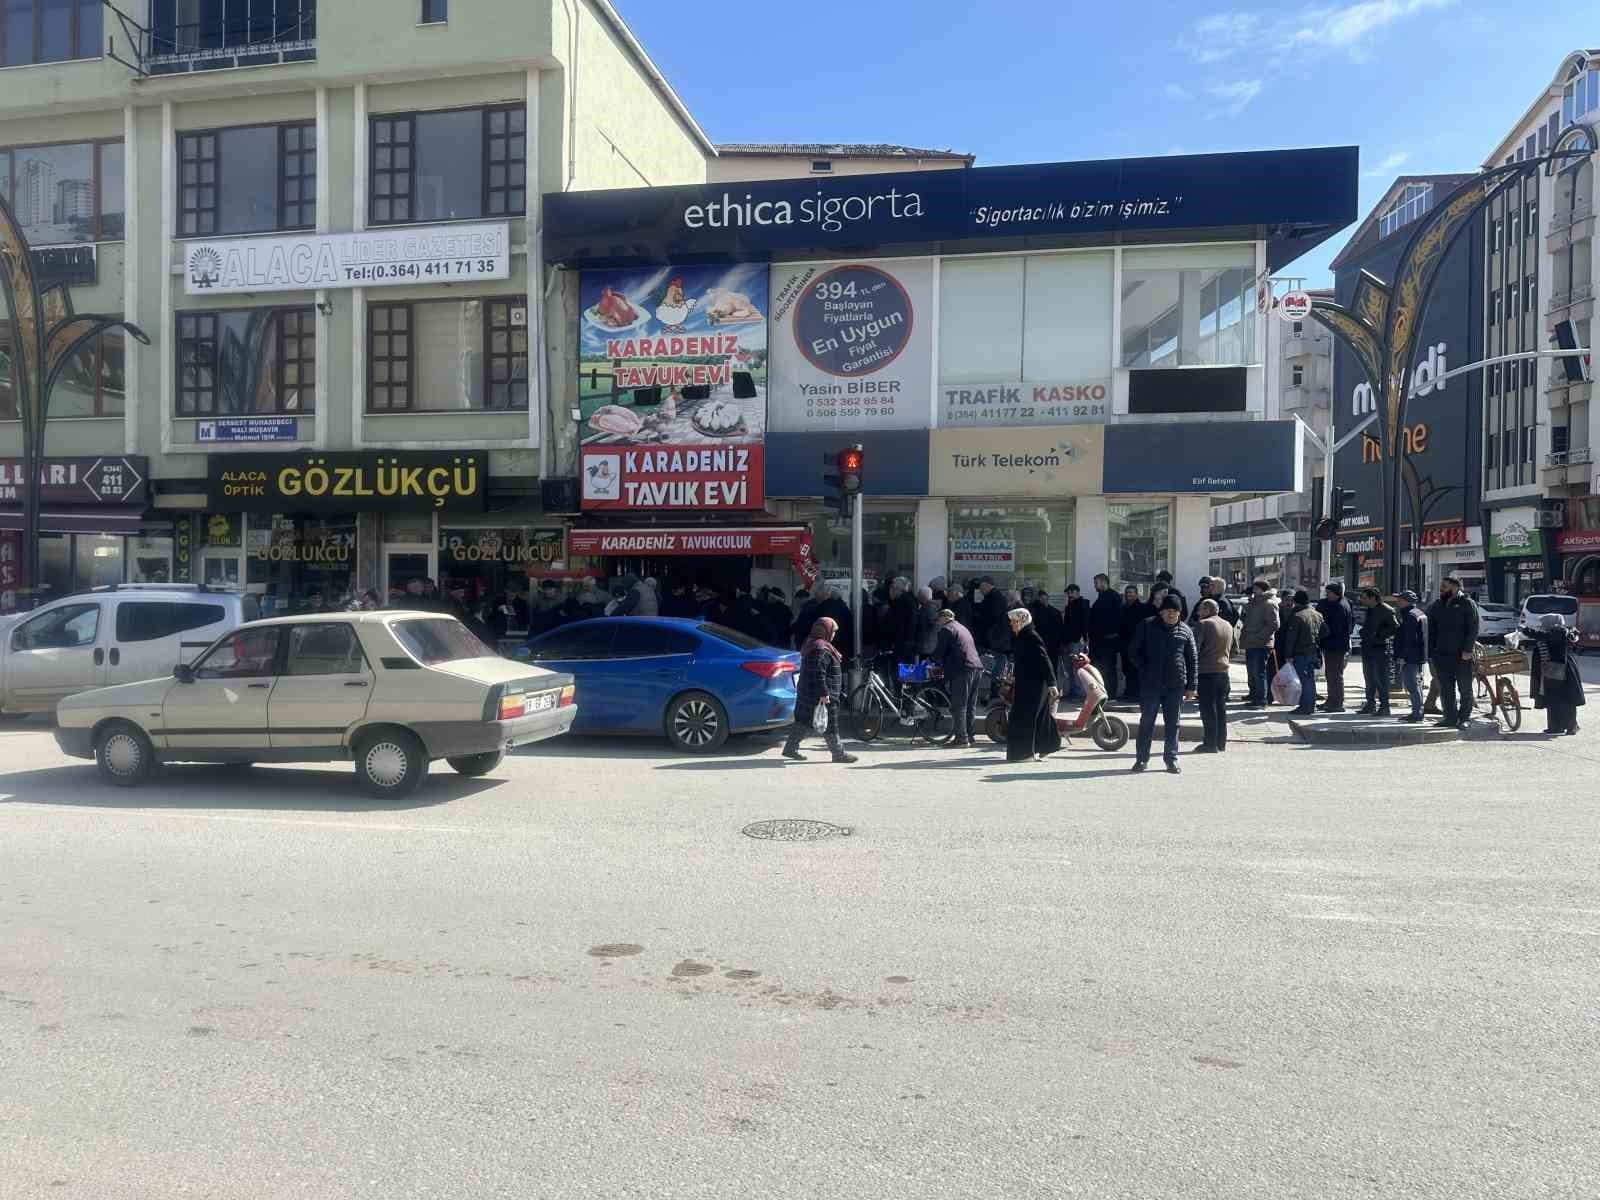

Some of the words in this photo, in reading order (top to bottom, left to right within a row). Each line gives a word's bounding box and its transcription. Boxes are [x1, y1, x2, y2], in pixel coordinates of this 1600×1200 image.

[684, 193, 794, 228] ethica
[799, 188, 926, 232] sigorta
[1070, 200, 1114, 219] bizim
[221, 243, 337, 287] ALACA
[402, 228, 503, 258] GAZETESİ
[425, 263, 449, 276] 411
[455, 261, 471, 274] 71
[477, 259, 495, 273] 35
[815, 281, 857, 300] 394
[824, 301, 873, 312] Başlayan
[823, 312, 874, 325] Fiyatlarla
[811, 337, 840, 356] En
[840, 311, 904, 343] Uygun
[607, 331, 738, 359] KARADENİZ
[848, 339, 878, 357] Fiyat
[841, 346, 895, 373] Garantisi
[613, 366, 689, 388] TAVUK
[692, 360, 734, 386] EVİ
[1353, 342, 1447, 416] mdi
[799, 384, 842, 396] Yasin
[847, 378, 901, 394] BİBER
[945, 385, 1021, 405] TRAFİK
[1031, 385, 1106, 403] KASKO
[1019, 407, 1035, 417] 22
[1361, 424, 1427, 464] he
[625, 445, 749, 473] KARADENİZ
[951, 453, 987, 468] Türk
[991, 453, 1060, 468] Telekom
[221, 471, 267, 481] ALACA
[278, 458, 477, 506] GÖZLÜKÇÜ
[223, 483, 264, 496] OPTİK
[624, 480, 700, 505] TAVUK
[703, 475, 747, 505] EVİ
[601, 533, 676, 549] KARADENİZ
[680, 535, 753, 549] TAVUKCULUK
